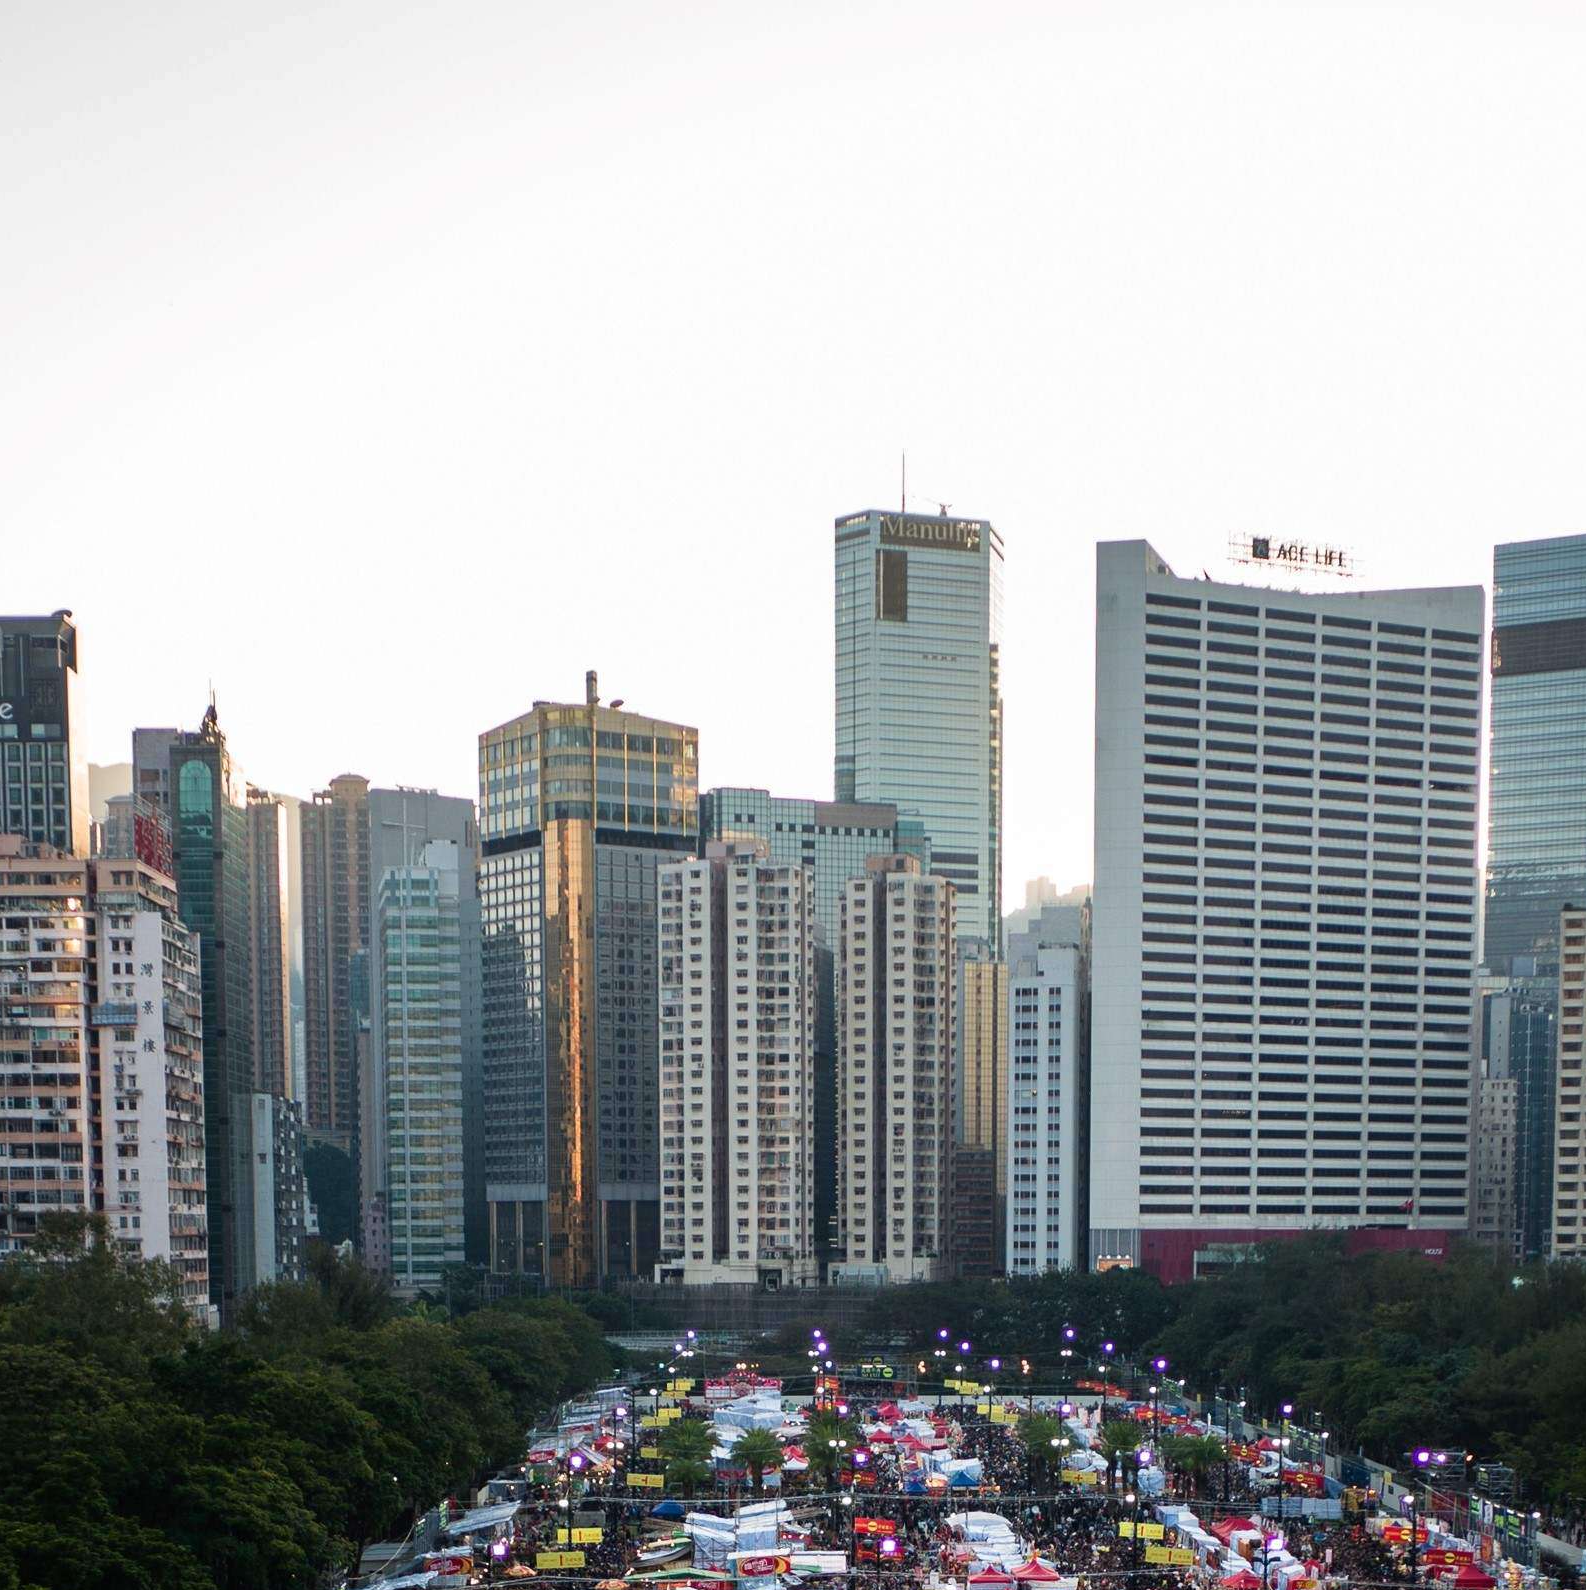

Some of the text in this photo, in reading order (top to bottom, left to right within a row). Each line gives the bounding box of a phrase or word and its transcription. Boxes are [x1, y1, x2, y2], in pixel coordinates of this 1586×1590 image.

[1277, 544, 1309, 563] ACE
[140, 962, 157, 1054] 灣景樓
